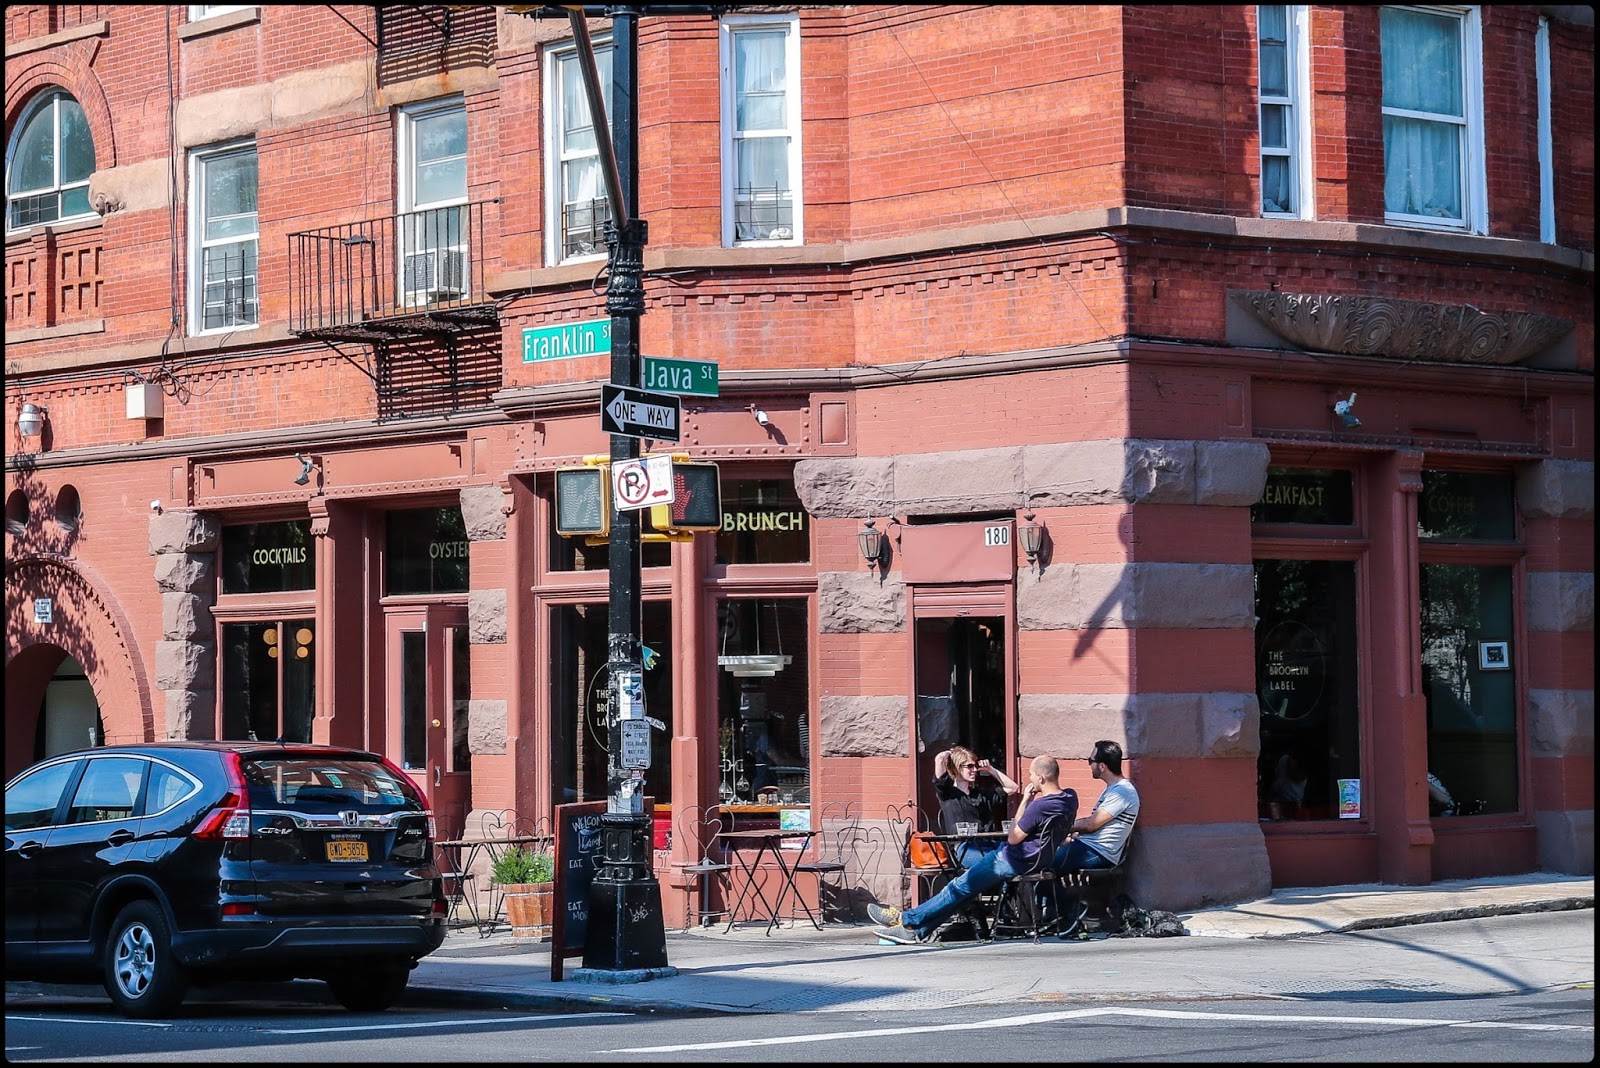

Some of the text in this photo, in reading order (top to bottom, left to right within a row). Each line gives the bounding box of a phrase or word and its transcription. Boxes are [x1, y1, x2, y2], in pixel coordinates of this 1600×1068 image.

[523, 326, 595, 360] Franklin
[647, 361, 713, 390] Java St
[614, 402, 671, 427] ONE WAY
[1258, 485, 1324, 506] EAKFAST
[723, 511, 803, 532] BRUNCH
[986, 527, 1008, 545] 180
[253, 547, 307, 565] COCKTAILS
[1268, 651, 1284, 661] THE
[596, 689, 609, 699] THE
[1270, 680, 1296, 691] LABEL
[569, 858, 583, 869] EAT
[567, 900, 583, 911] EAT
